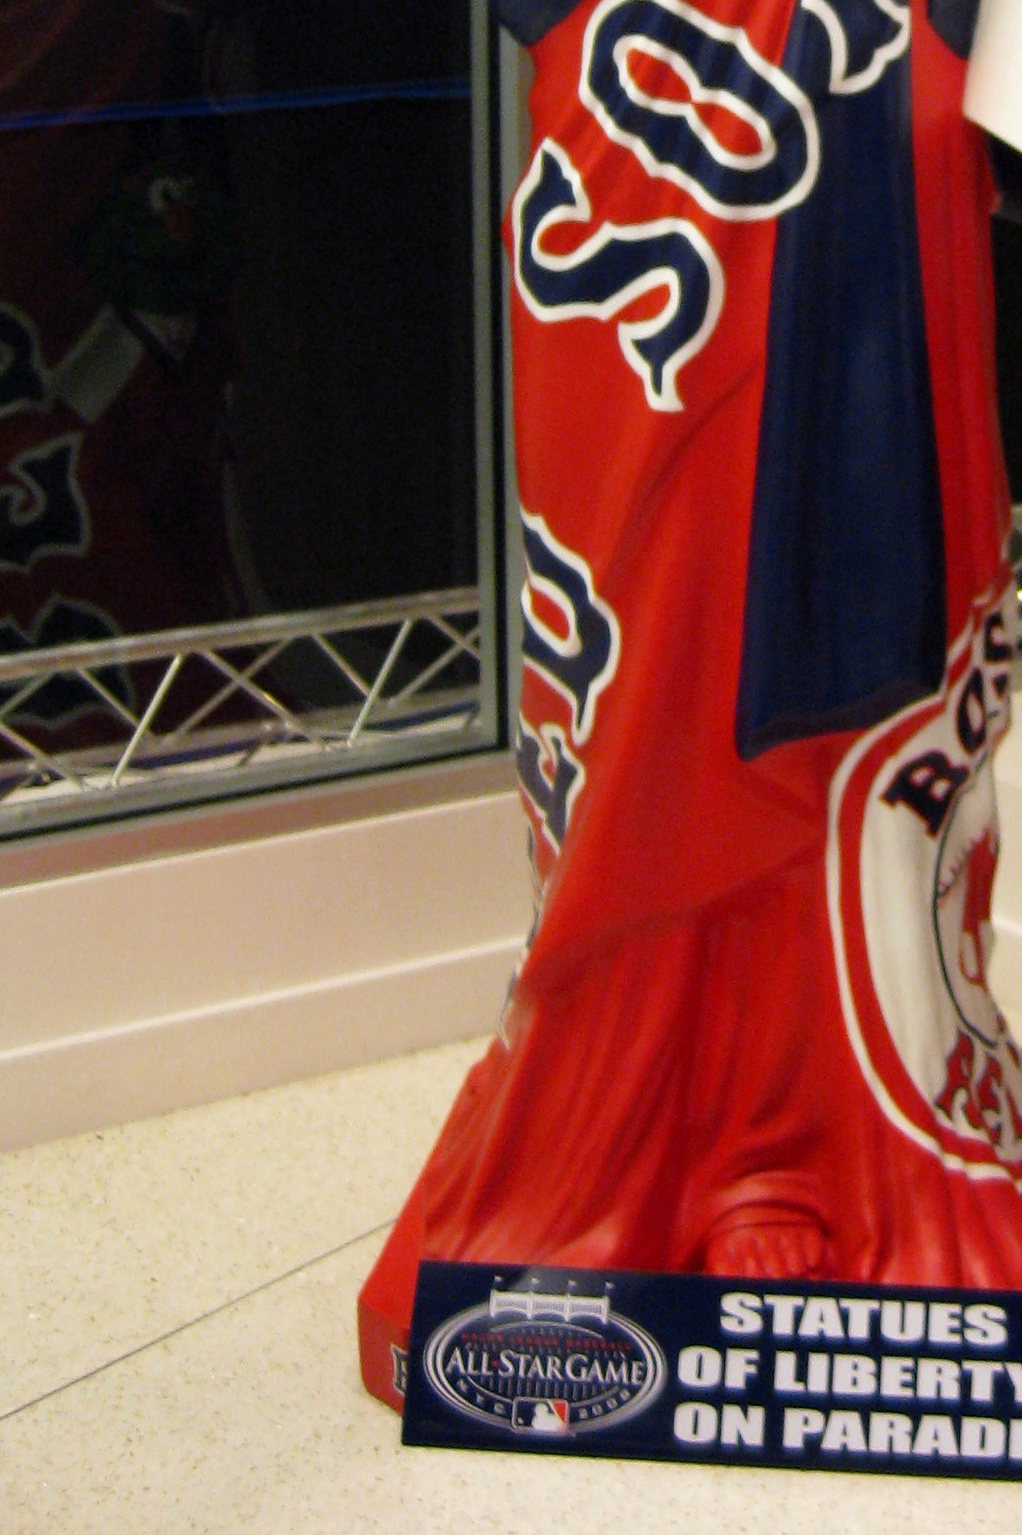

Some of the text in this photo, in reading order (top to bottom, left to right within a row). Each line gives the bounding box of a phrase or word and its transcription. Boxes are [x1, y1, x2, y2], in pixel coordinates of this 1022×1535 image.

[720, 1292, 1009, 1346] STATUES
[497, 1349, 563, 1381] STAR
[565, 1353, 646, 1386] GAME
[677, 1345, 760, 1389] OF
[673, 1401, 766, 1448] ON
